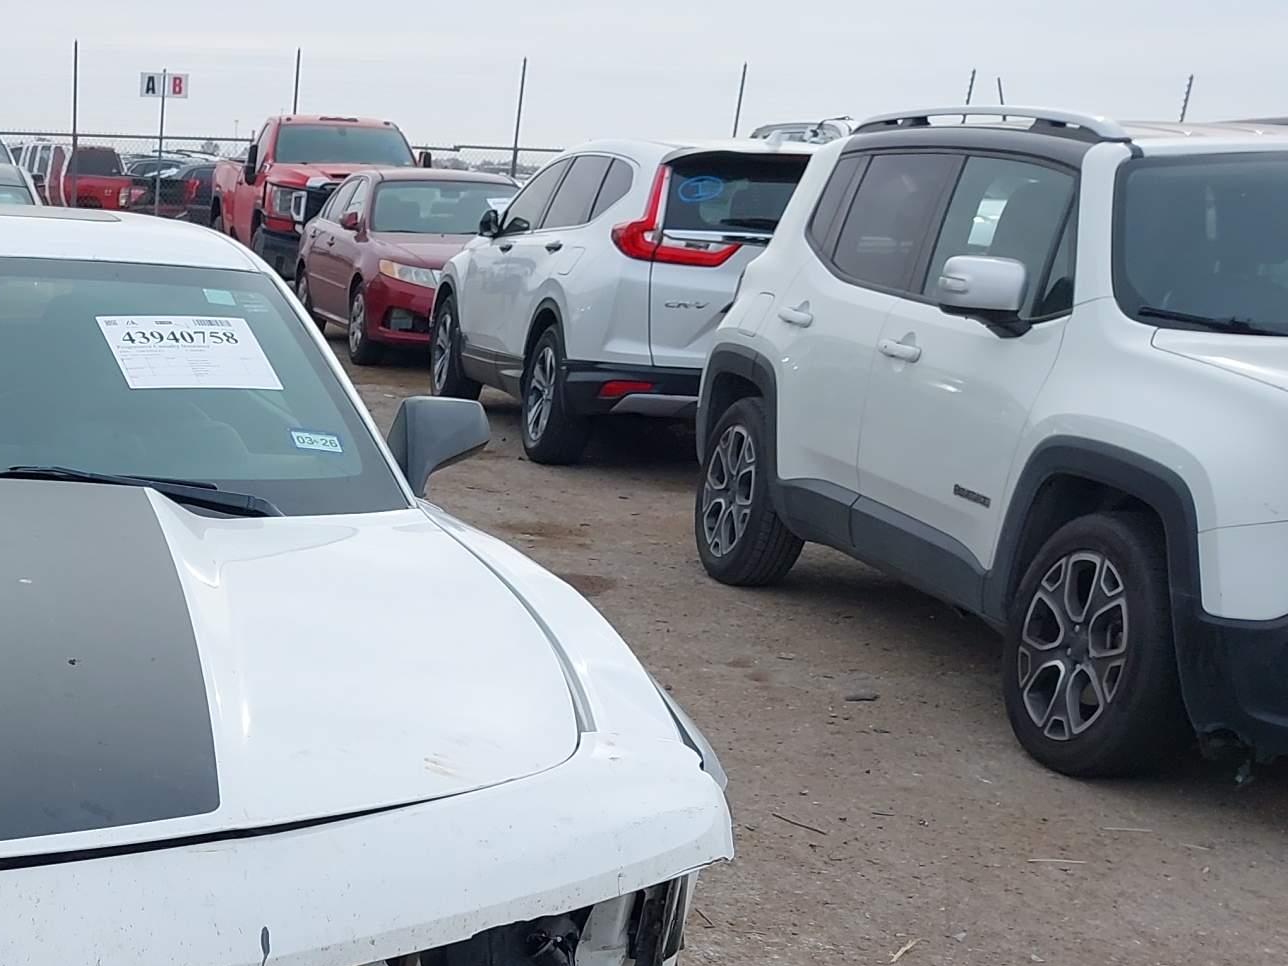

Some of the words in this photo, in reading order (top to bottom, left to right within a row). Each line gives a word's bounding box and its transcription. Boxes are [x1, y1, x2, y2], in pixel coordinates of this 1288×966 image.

[145, 76, 156, 94] A
[173, 77, 182, 95] B
[122, 331, 239, 344] 43940758
